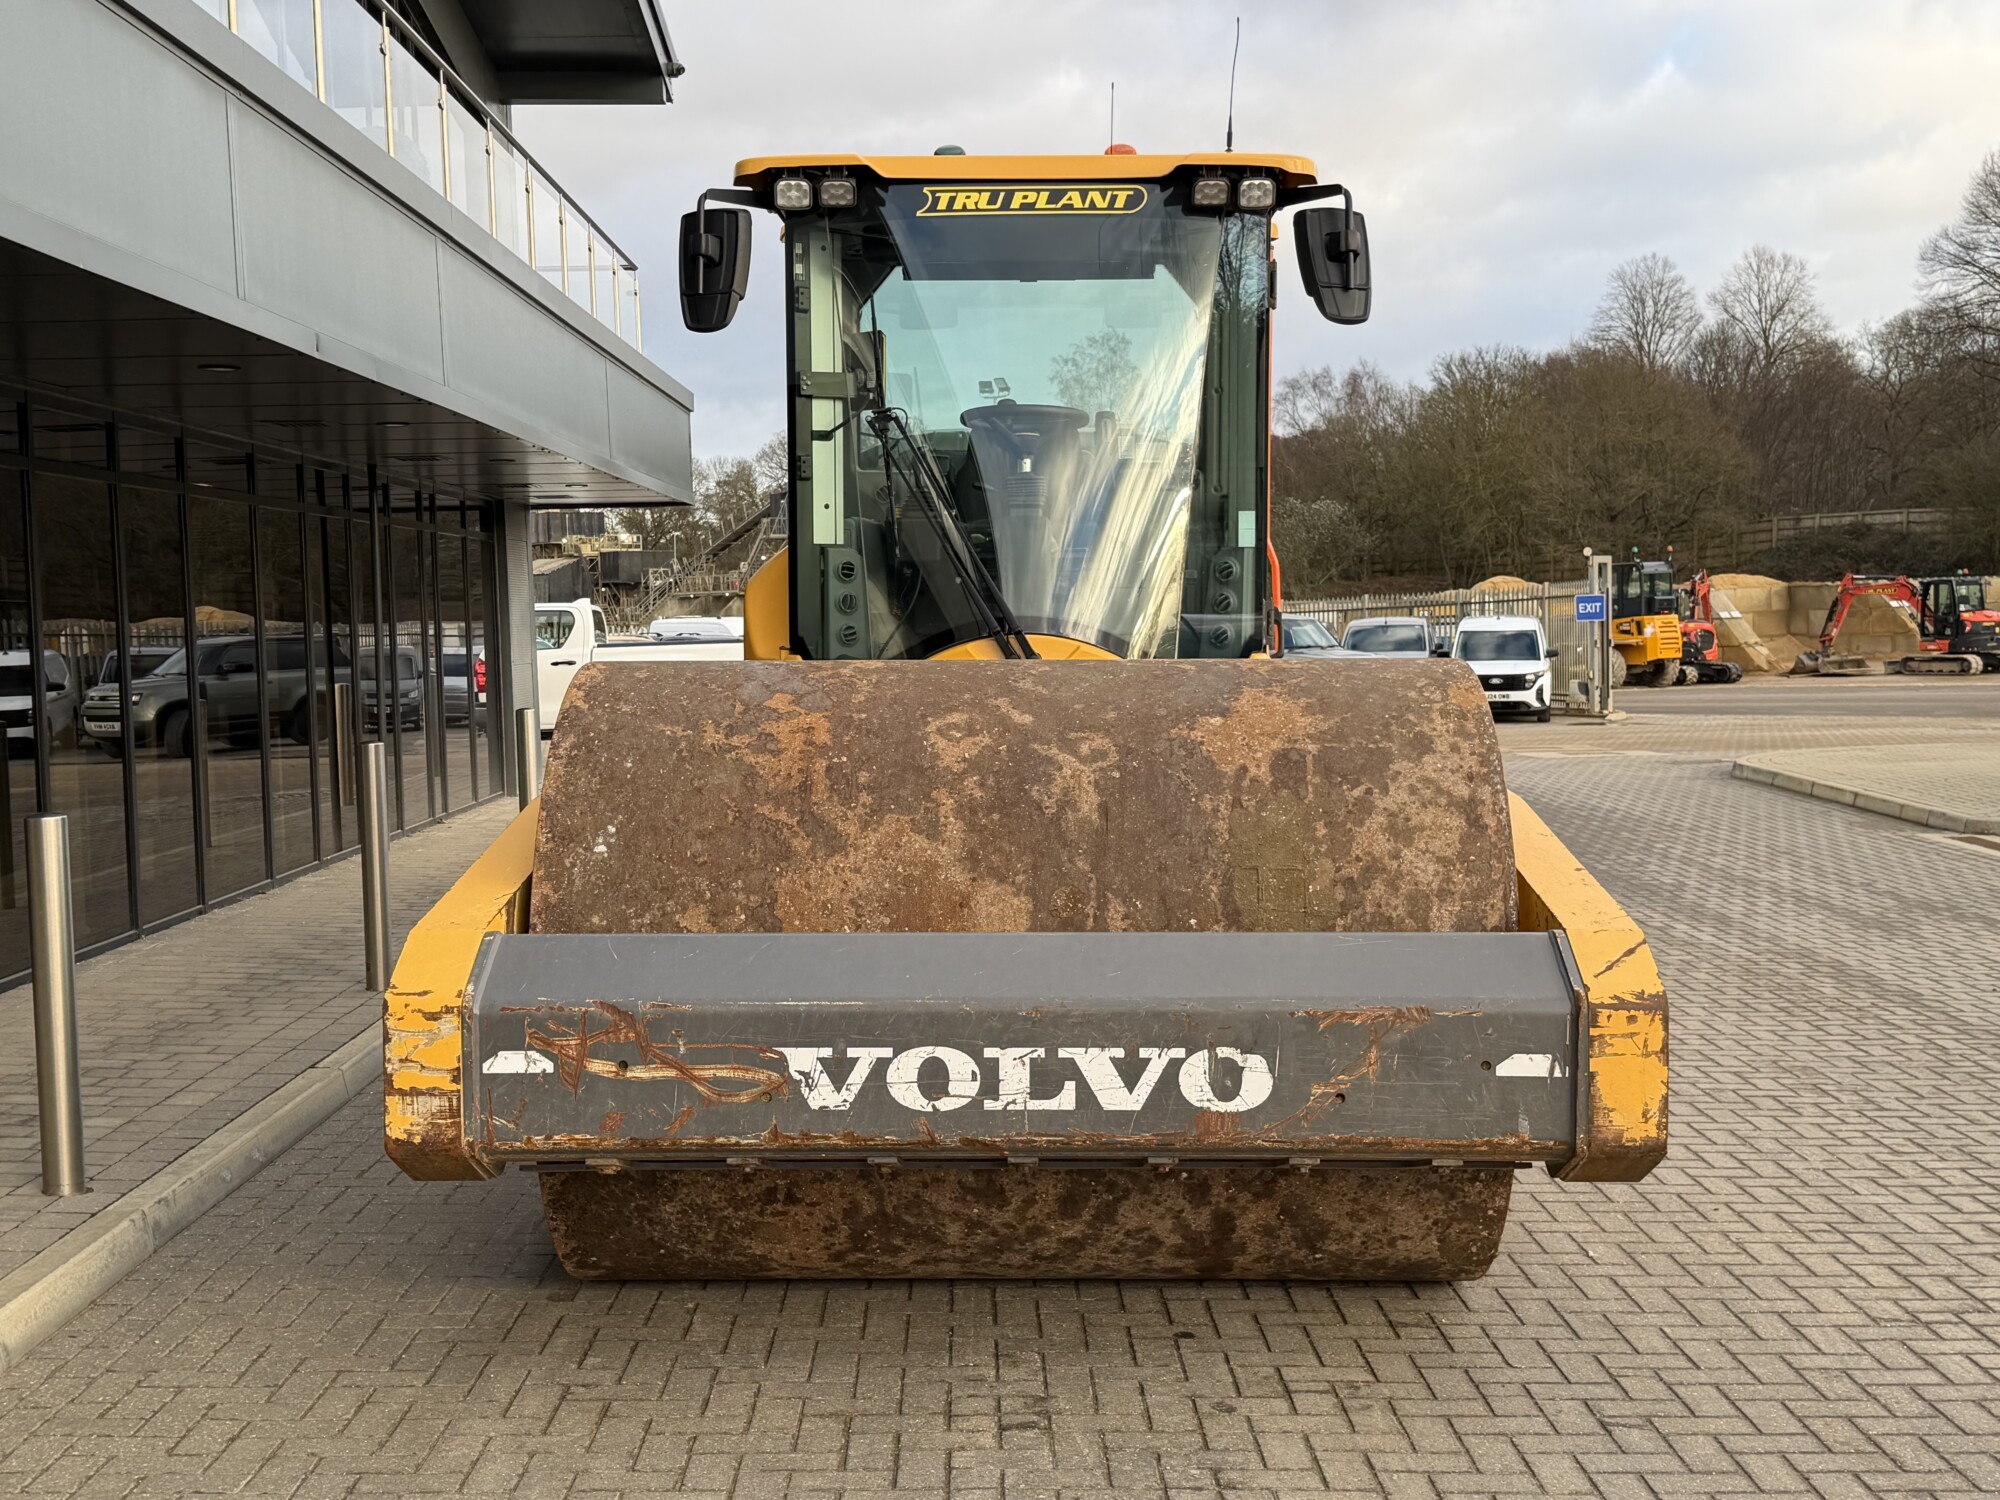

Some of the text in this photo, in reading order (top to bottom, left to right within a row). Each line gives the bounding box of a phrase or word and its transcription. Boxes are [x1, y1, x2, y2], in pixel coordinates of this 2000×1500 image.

[935, 190, 1134, 210] TRU PLANT
[1578, 602, 1602, 613] EXIT
[776, 1045, 1274, 1113] VOLVO
